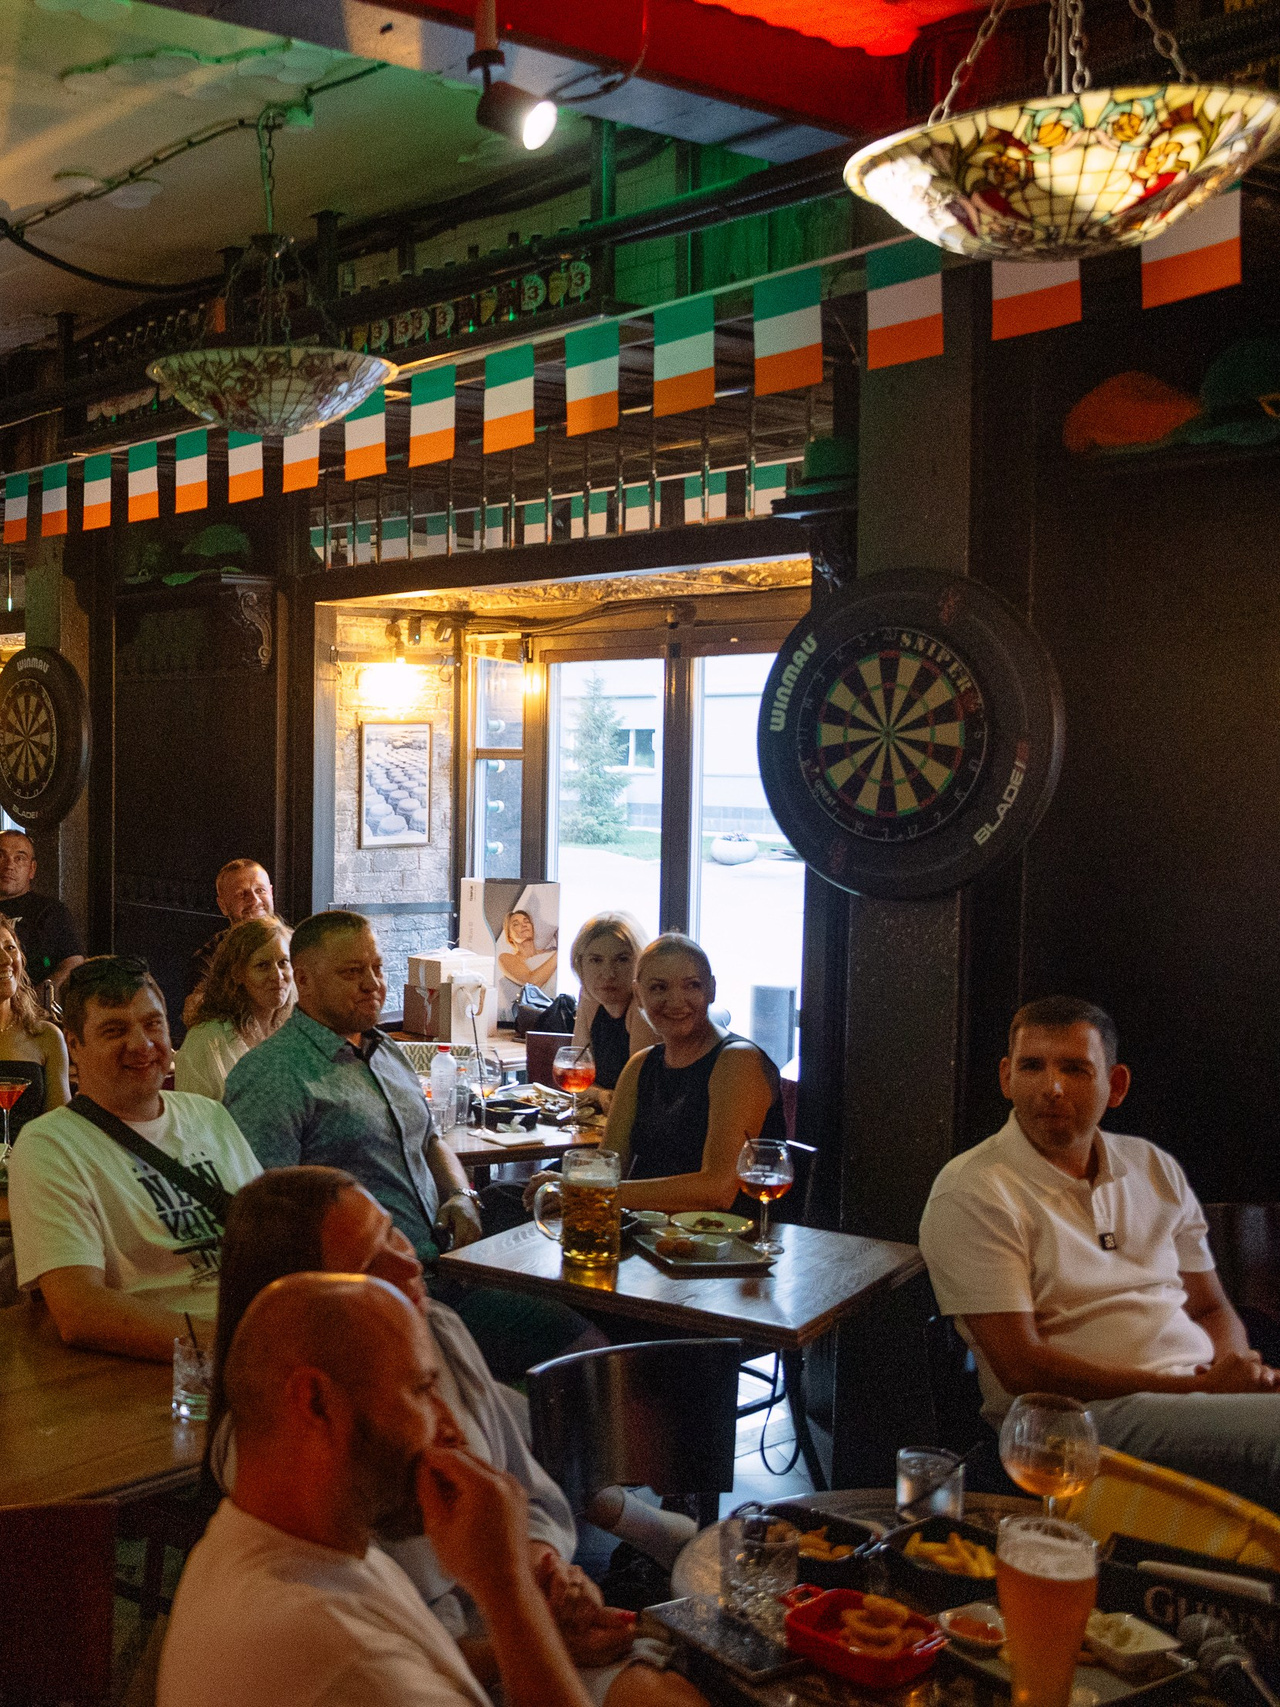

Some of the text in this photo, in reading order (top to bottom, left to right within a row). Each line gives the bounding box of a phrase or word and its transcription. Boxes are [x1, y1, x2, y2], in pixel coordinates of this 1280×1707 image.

[16, 657, 50, 674] WINMAU
[769, 632, 818, 732] WINMAU
[900, 632, 972, 693] SNIPER
